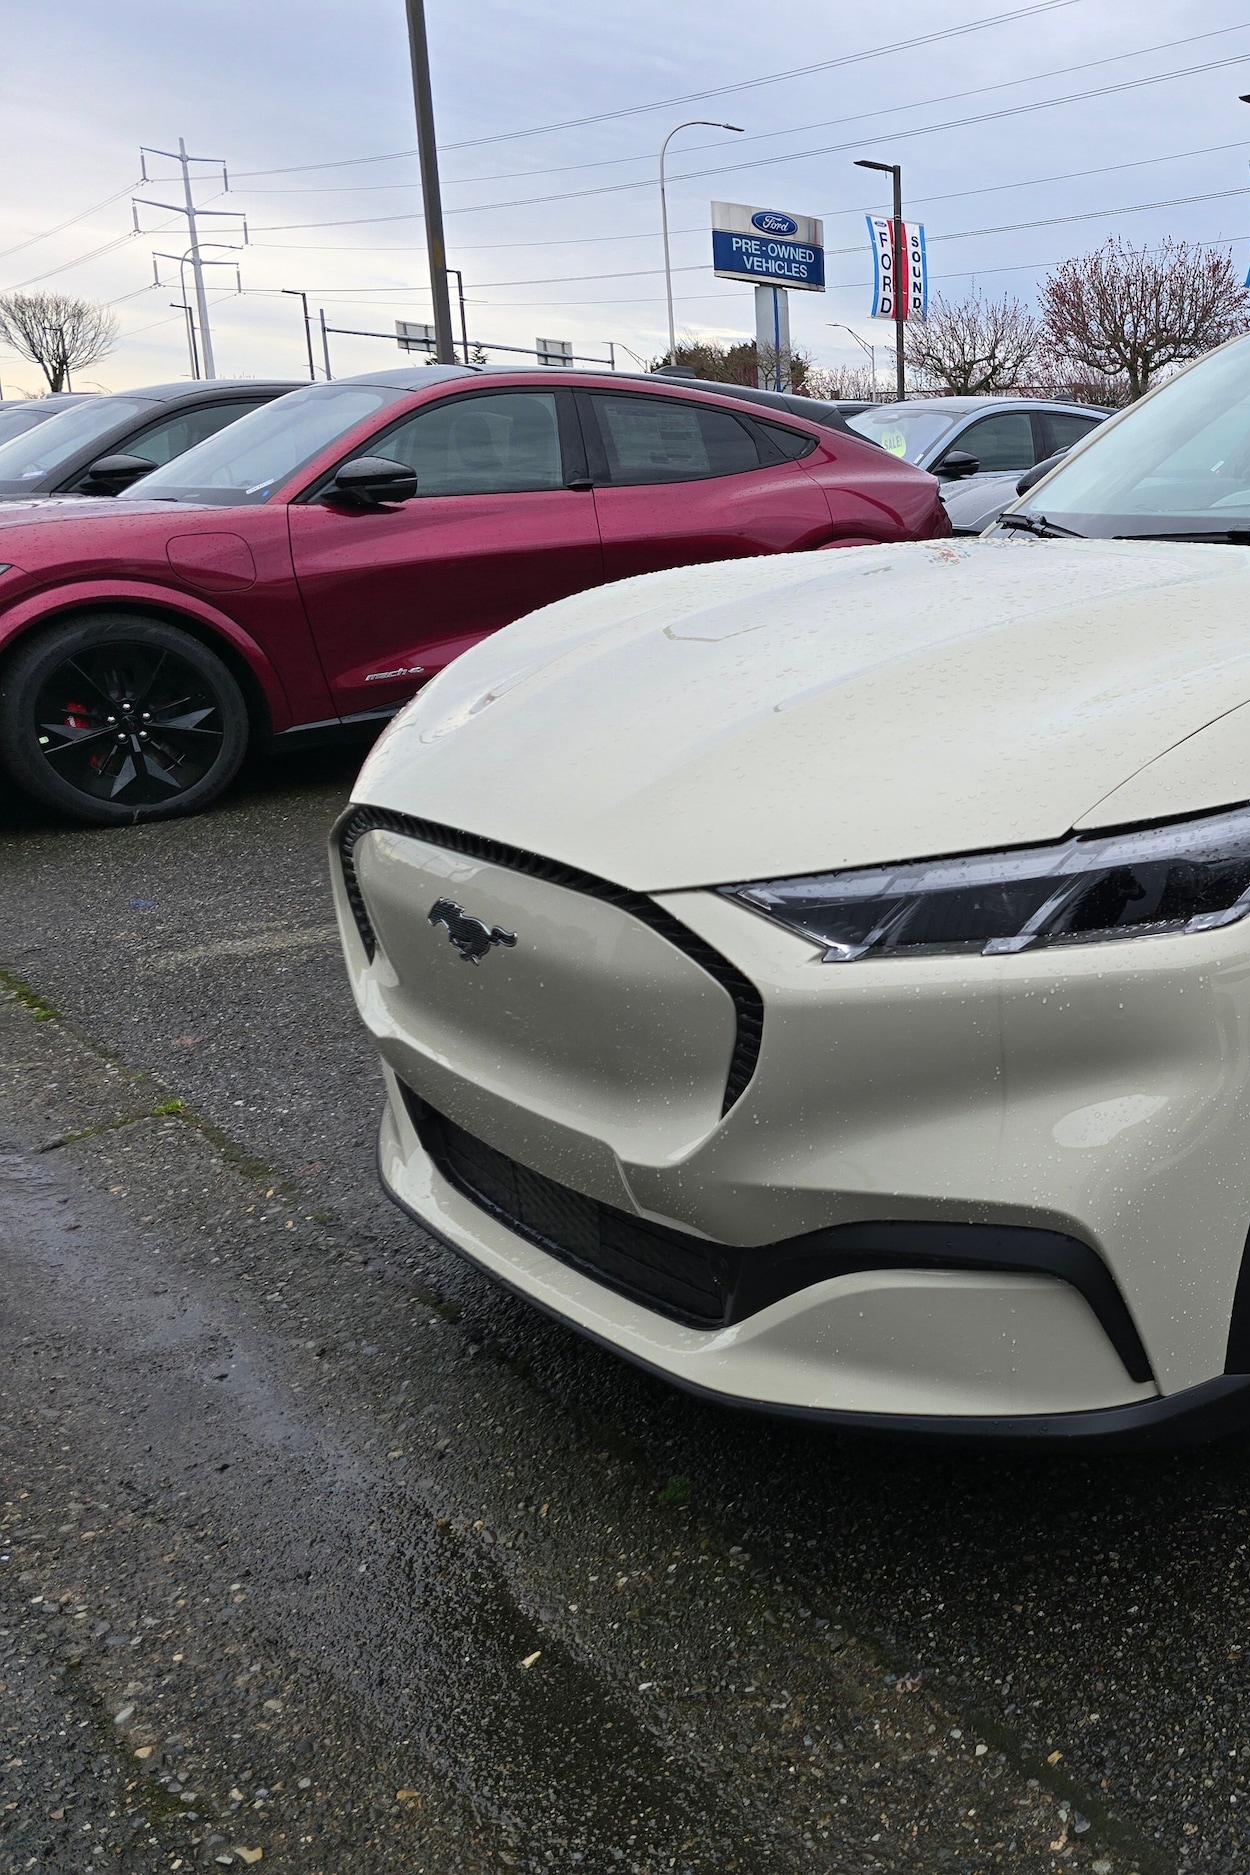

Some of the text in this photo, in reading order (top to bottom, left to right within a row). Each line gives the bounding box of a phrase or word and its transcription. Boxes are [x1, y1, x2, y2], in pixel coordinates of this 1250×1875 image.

[763, 215, 788, 231] Ford
[732, 237, 815, 263] PRE-OWNED
[743, 255, 808, 278] VEHICLES
[879, 231, 892, 313] FORD
[911, 236, 922, 309] SOUND
